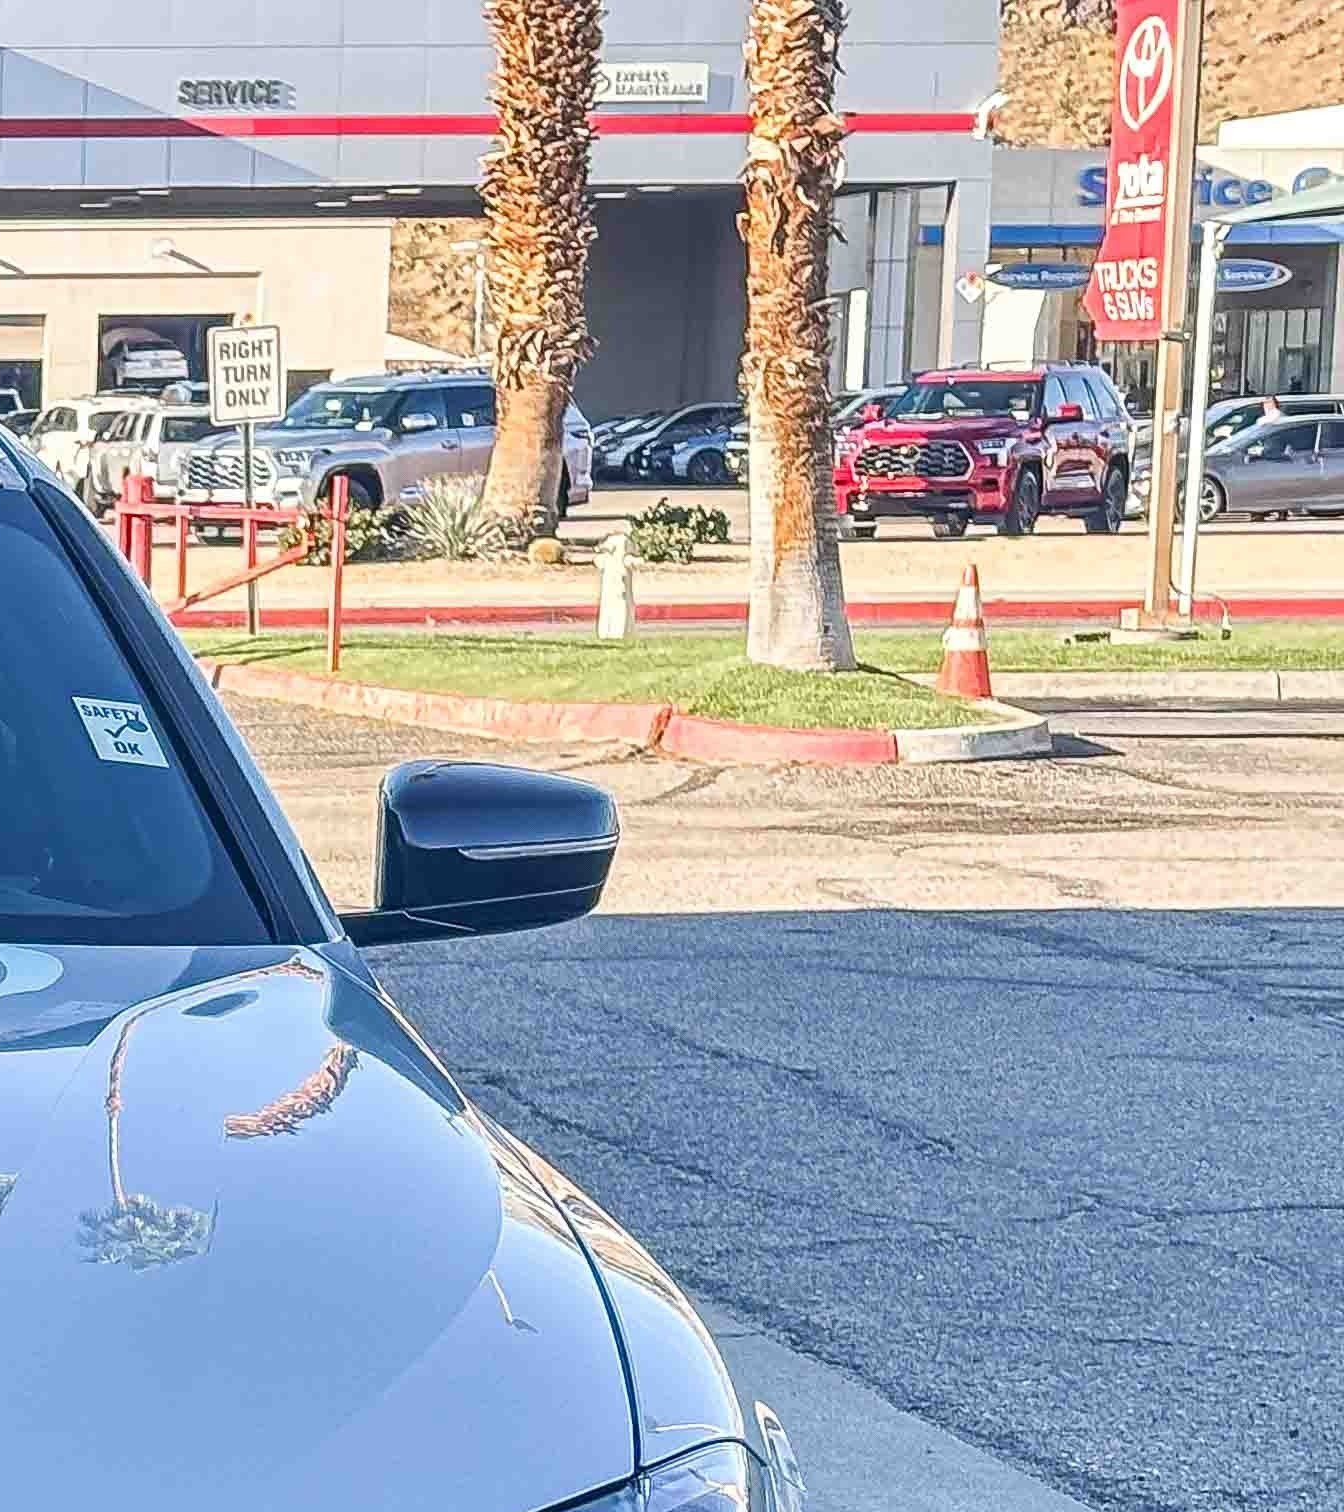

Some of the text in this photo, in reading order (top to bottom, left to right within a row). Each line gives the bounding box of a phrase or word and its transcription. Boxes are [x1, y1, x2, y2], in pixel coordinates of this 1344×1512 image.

[177, 80, 282, 105] SERVICE
[1093, 257, 1158, 293] TRUCKS
[219, 340, 273, 360] RIGHT
[223, 363, 271, 384] TURN
[225, 387, 270, 407] ONLY
[81, 704, 140, 721] SAFETY
[114, 741, 143, 756] OK
